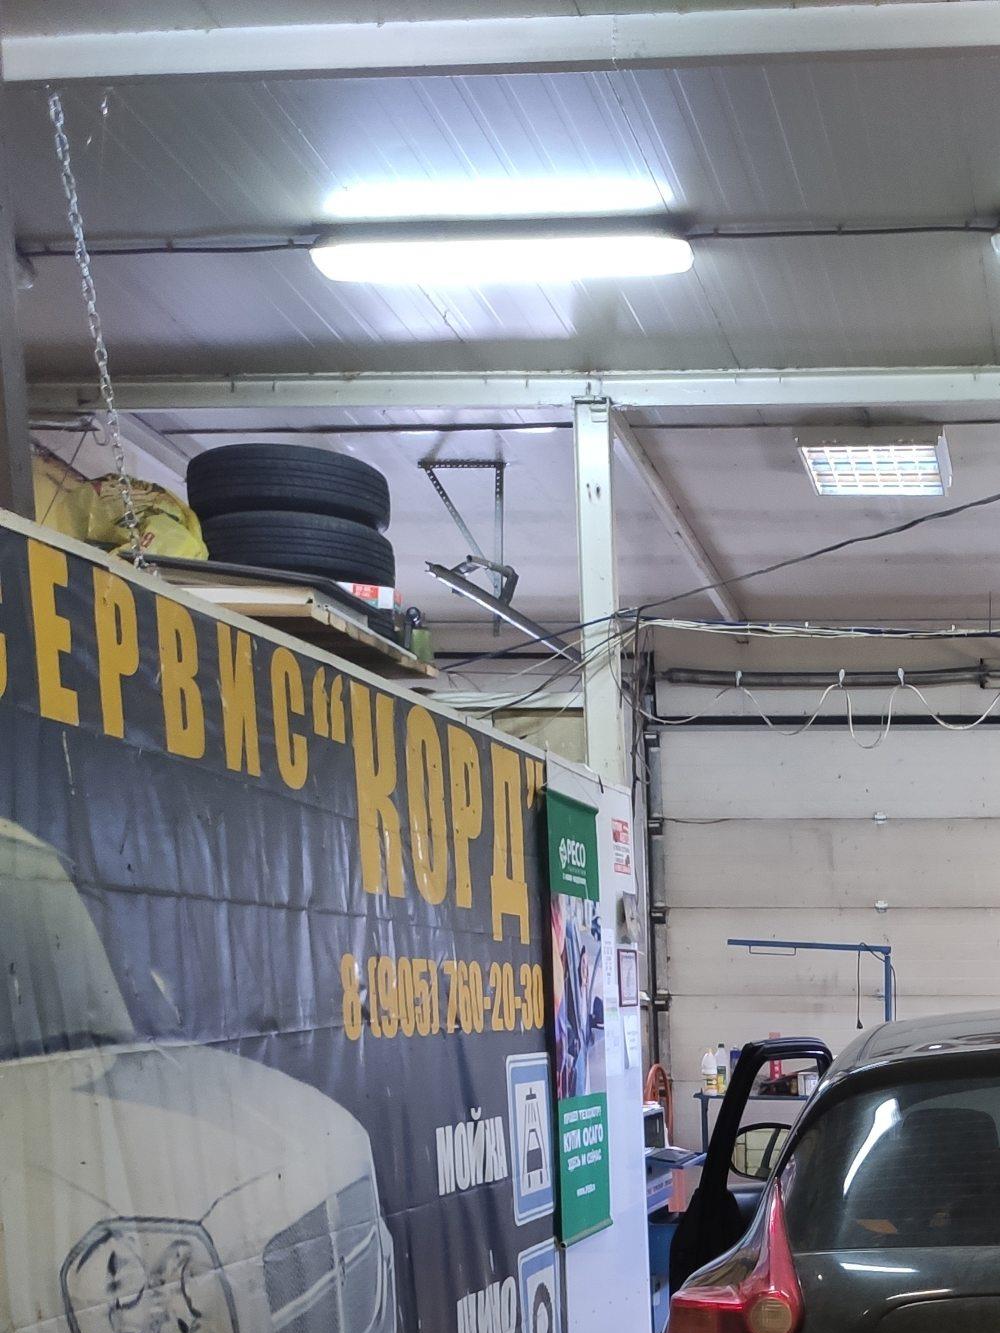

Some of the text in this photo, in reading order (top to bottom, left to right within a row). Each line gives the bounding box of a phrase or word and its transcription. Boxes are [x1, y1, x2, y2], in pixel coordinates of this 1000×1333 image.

[0, 539, 308, 789] ЕРВИС
[341, 953, 362, 1040] 8
[368, 956, 440, 1038] (905)
[444, 960, 544, 1034] 760-20-30
[436, 1106, 509, 1196] МОЙКА
